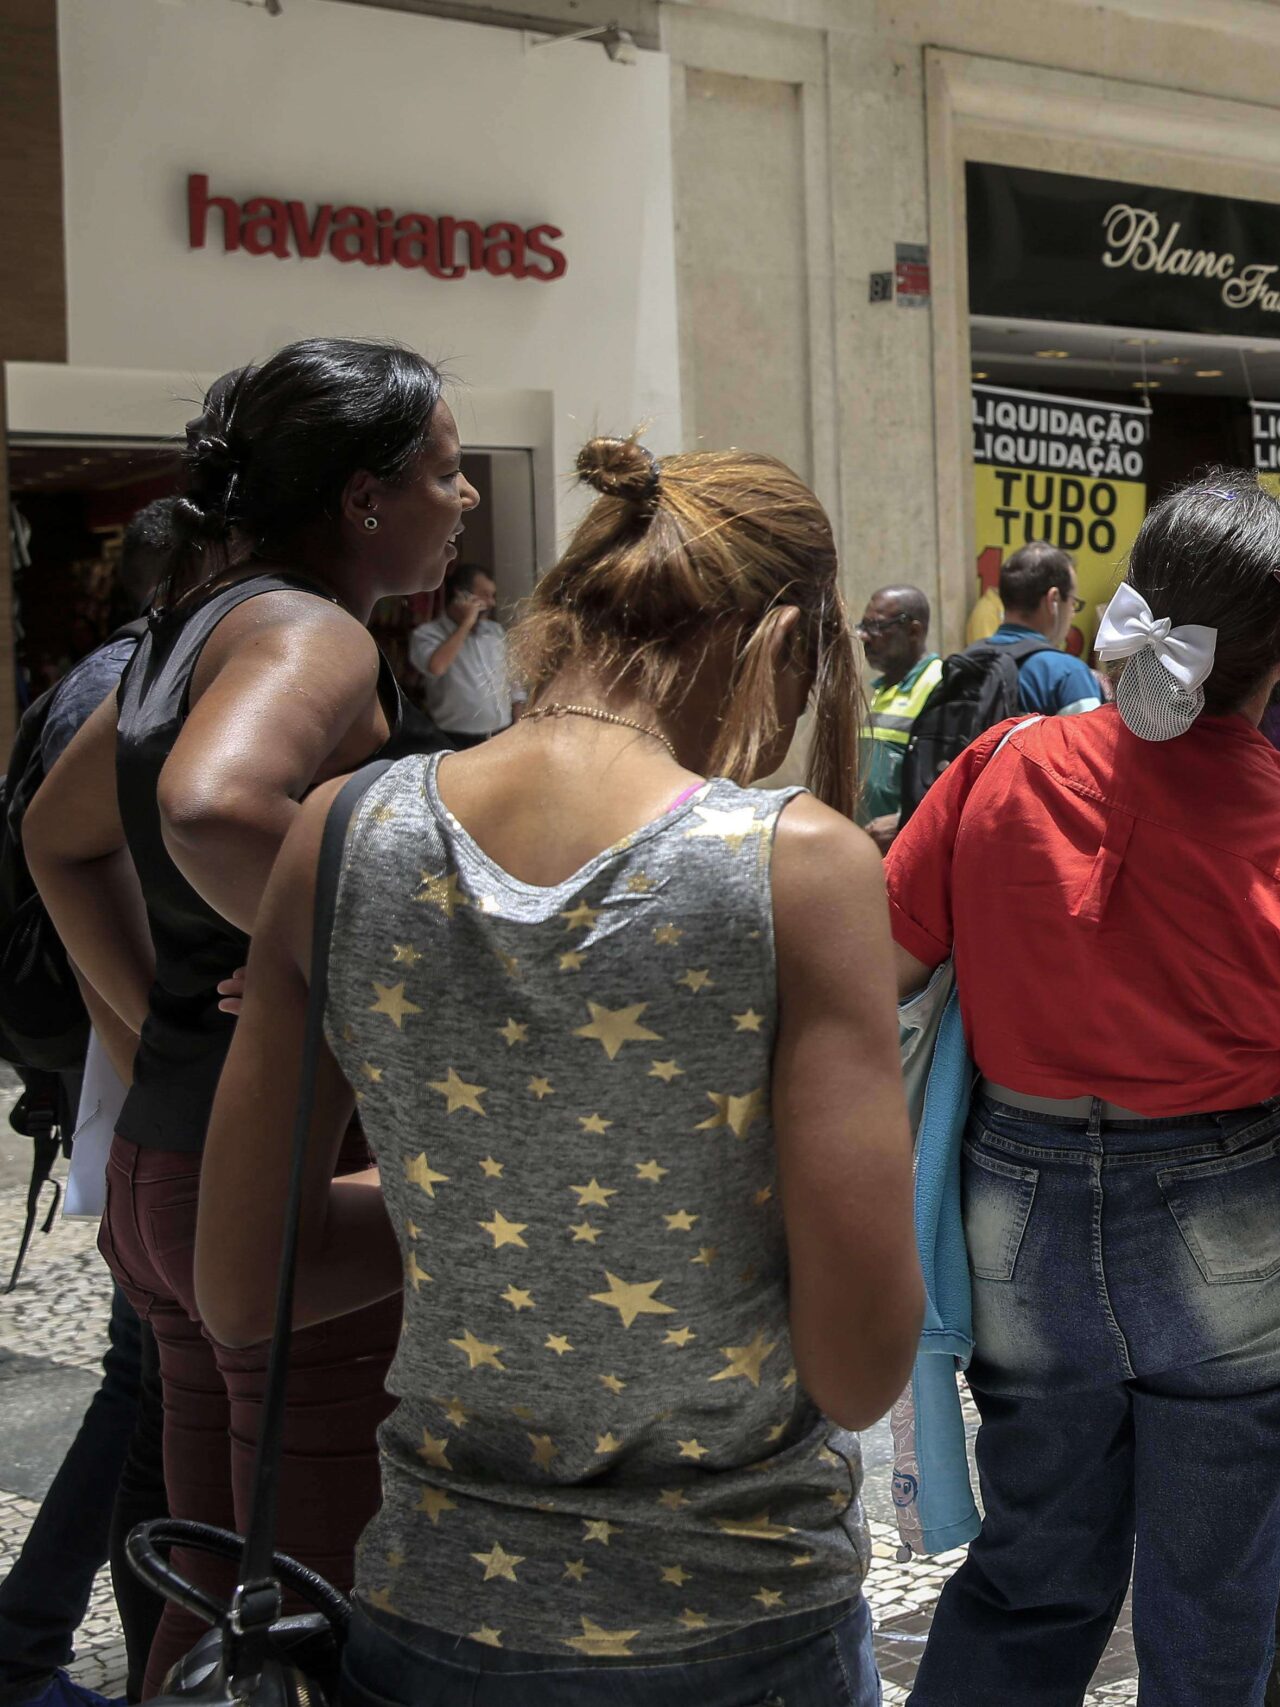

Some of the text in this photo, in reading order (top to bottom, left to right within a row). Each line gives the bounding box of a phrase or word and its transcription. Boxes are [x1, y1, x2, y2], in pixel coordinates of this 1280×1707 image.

[187, 173, 567, 283] havaianas
[1102, 203, 1235, 280] Blanc
[973, 398, 1145, 446] LIQUIDAÇÃO
[995, 471, 1117, 517] TUDO
[995, 508, 1116, 554] TUDO
